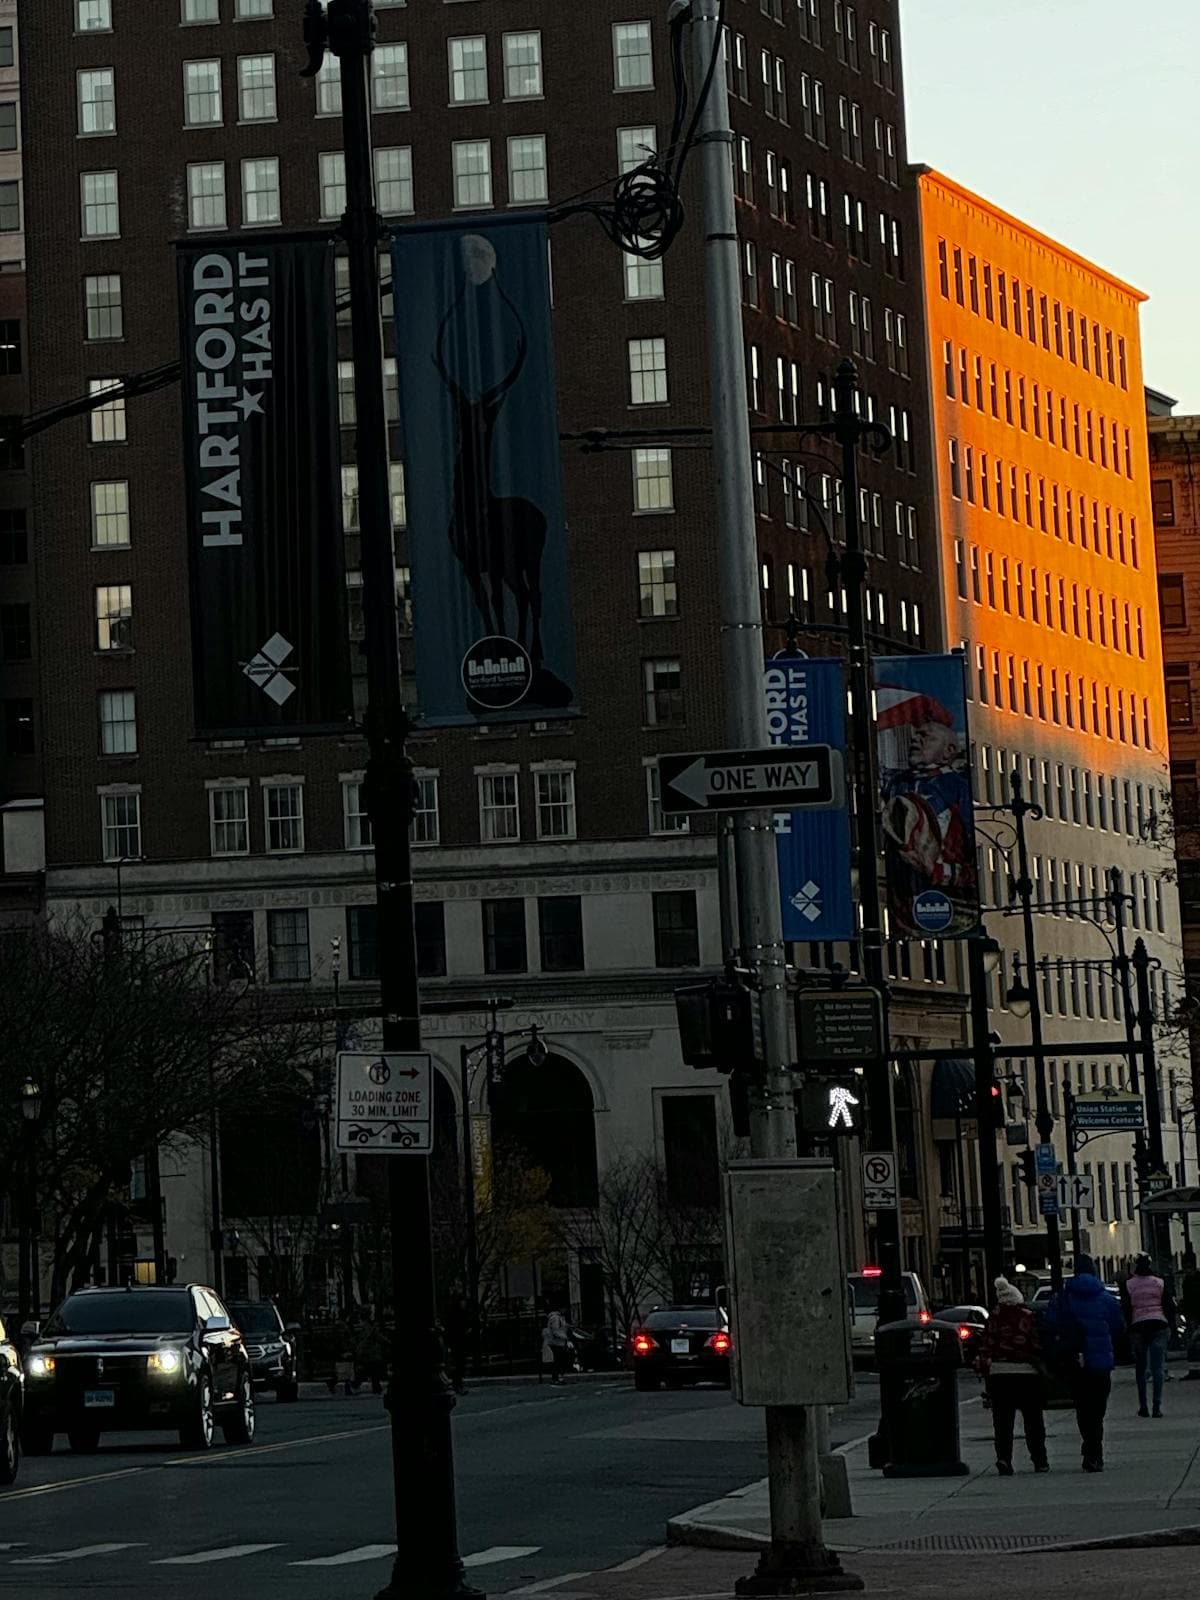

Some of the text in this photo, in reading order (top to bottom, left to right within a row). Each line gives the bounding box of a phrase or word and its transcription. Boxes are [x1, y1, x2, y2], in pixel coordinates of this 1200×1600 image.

[237, 251, 273, 380] HAS IT
[192, 253, 244, 548] HARTFORD
[788, 668, 809, 741] HAS IT
[765, 668, 793, 834] HFORD
[710, 764, 812, 792] ONE WAY
[515, 1011, 596, 1029] COMPANY
[349, 1090, 421, 1103] LOADING ZONE
[351, 1104, 419, 1117] 30 MIN. LIMIT
[1076, 1104, 1128, 1113] Union Station
[1077, 1116, 1135, 1125] Welcome Center
